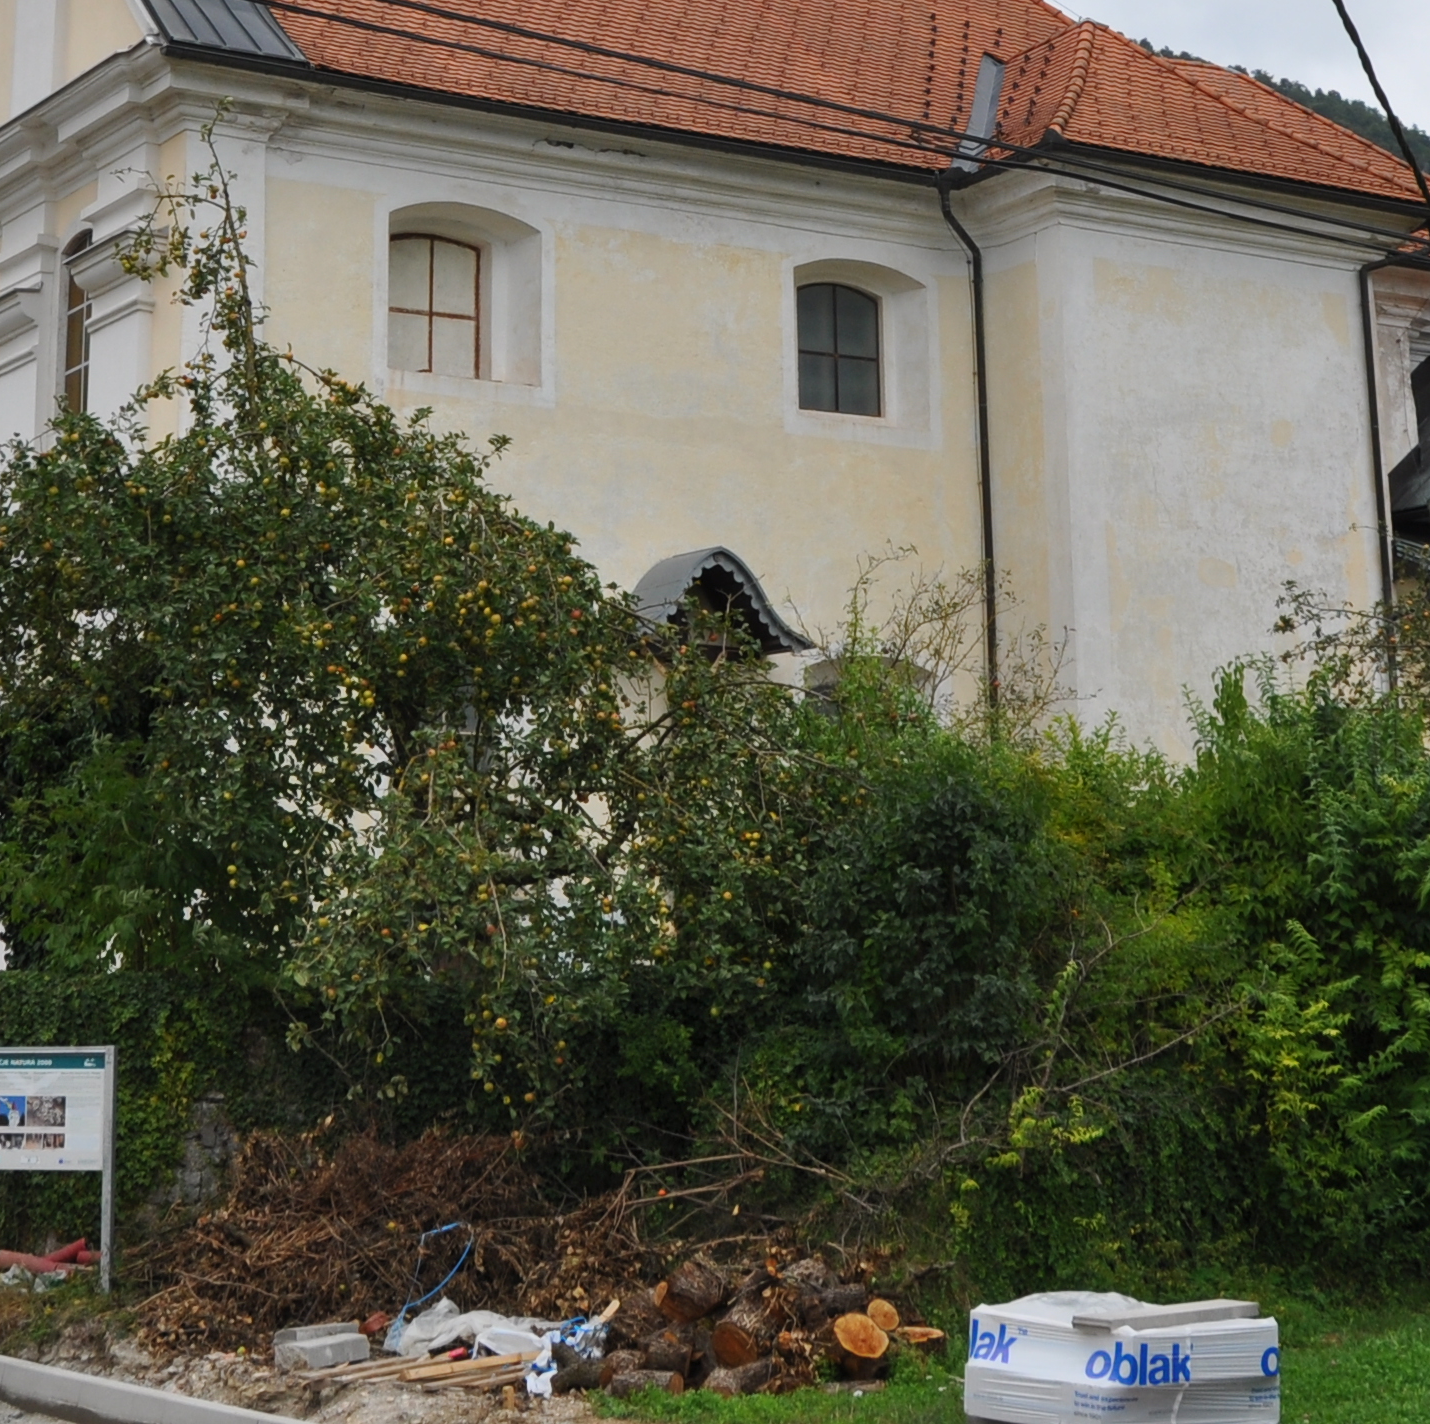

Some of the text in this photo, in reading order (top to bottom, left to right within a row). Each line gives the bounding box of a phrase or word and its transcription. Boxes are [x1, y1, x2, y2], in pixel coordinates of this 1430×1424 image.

[970, 1318, 1017, 1364] lak
[1085, 1341, 1190, 1386] oblak
[1261, 1346, 1279, 1377] o
